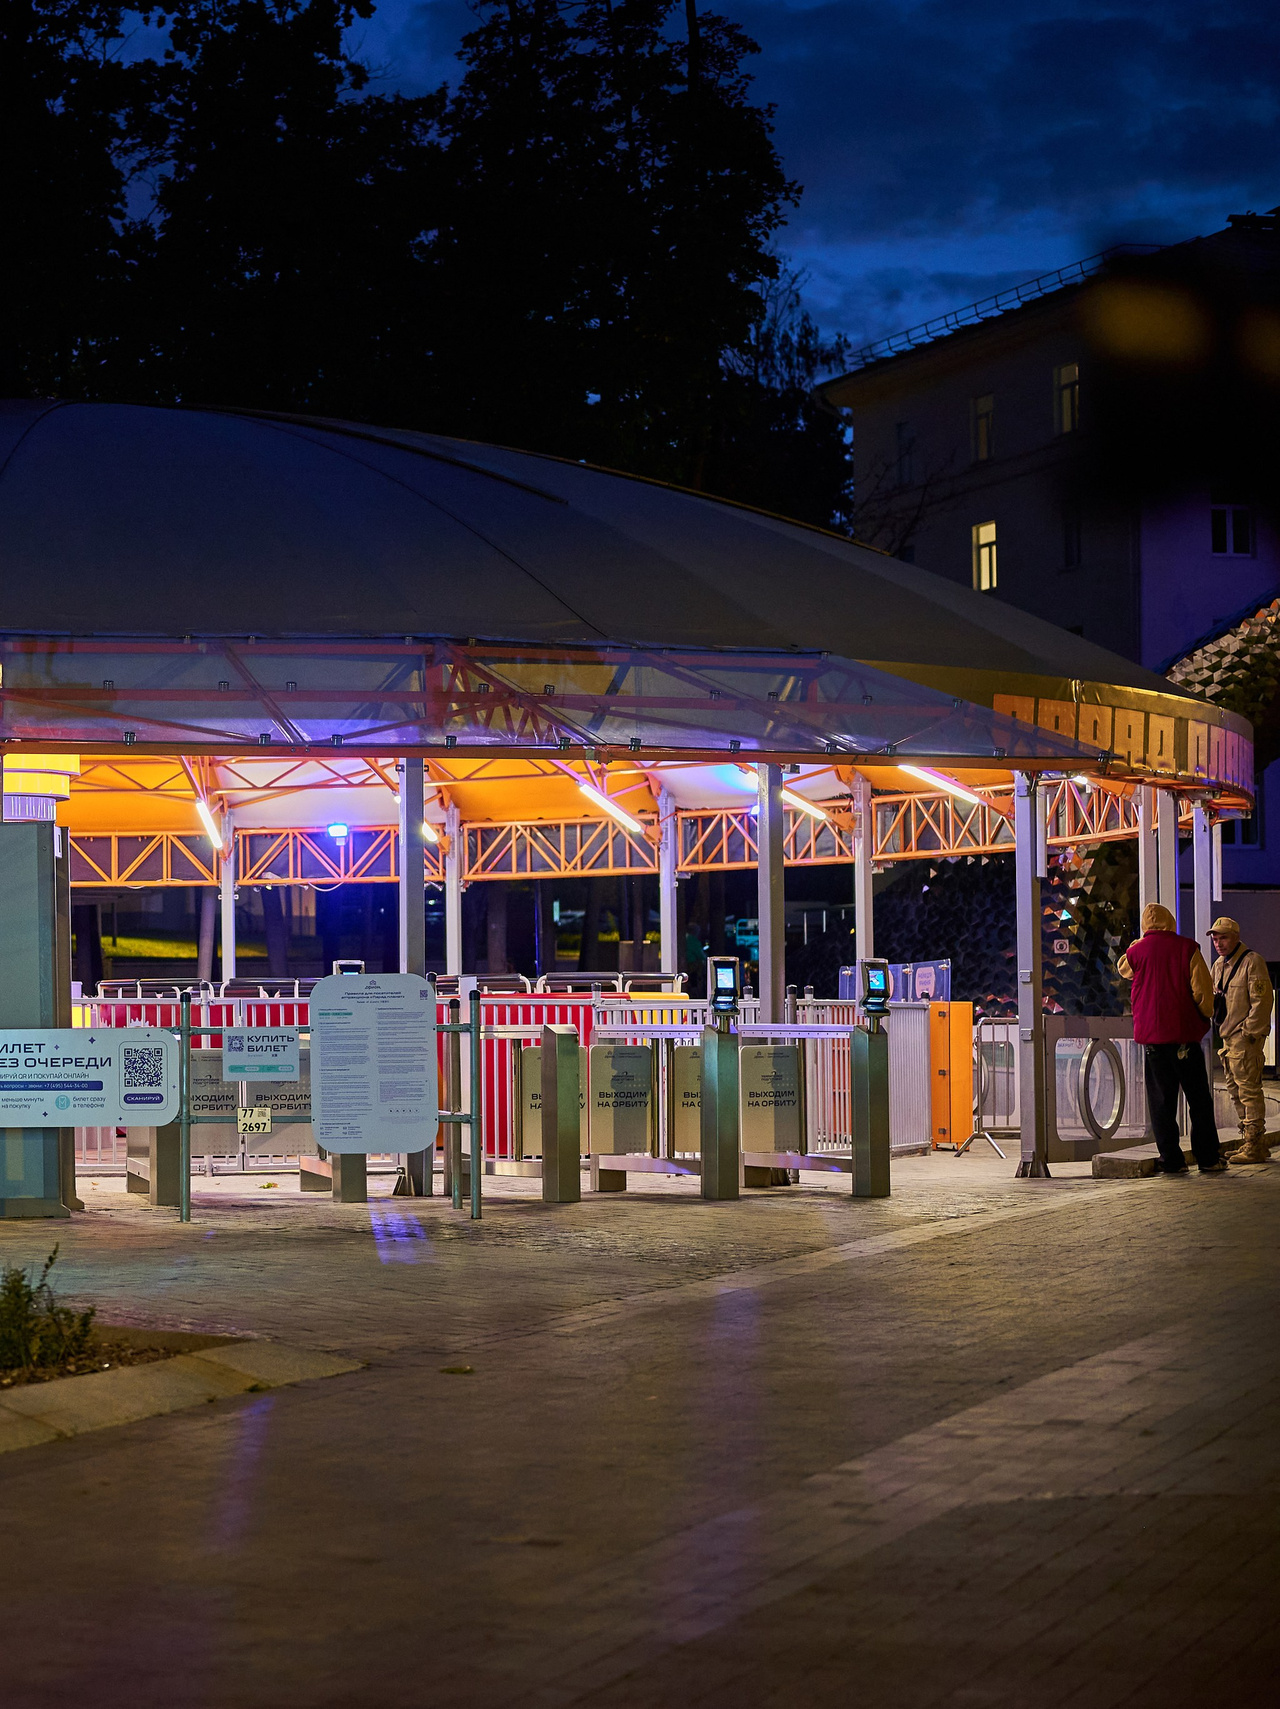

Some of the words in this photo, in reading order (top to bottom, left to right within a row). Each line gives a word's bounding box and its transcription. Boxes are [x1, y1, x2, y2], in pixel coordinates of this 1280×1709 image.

[247, 1035, 295, 1043] КУПИТЬ
[247, 1044, 288, 1052] БИЛЕТ
[24, 1057, 112, 1069] ОЧЕРЕДИ
[63, 1071, 89, 1079] ОНЛАЙН
[191, 1094, 235, 1102] ХОДИМ
[255, 1094, 312, 1102] ВЫХОДИМ
[598, 1091, 647, 1099] ВЫХОДИМ
[749, 1090, 795, 1099] ВЫХОДИМ
[761, 1099, 797, 1107] ОРБИТУ
[241, 1109, 254, 1118] 77
[242, 1123, 267, 1132] 2697
